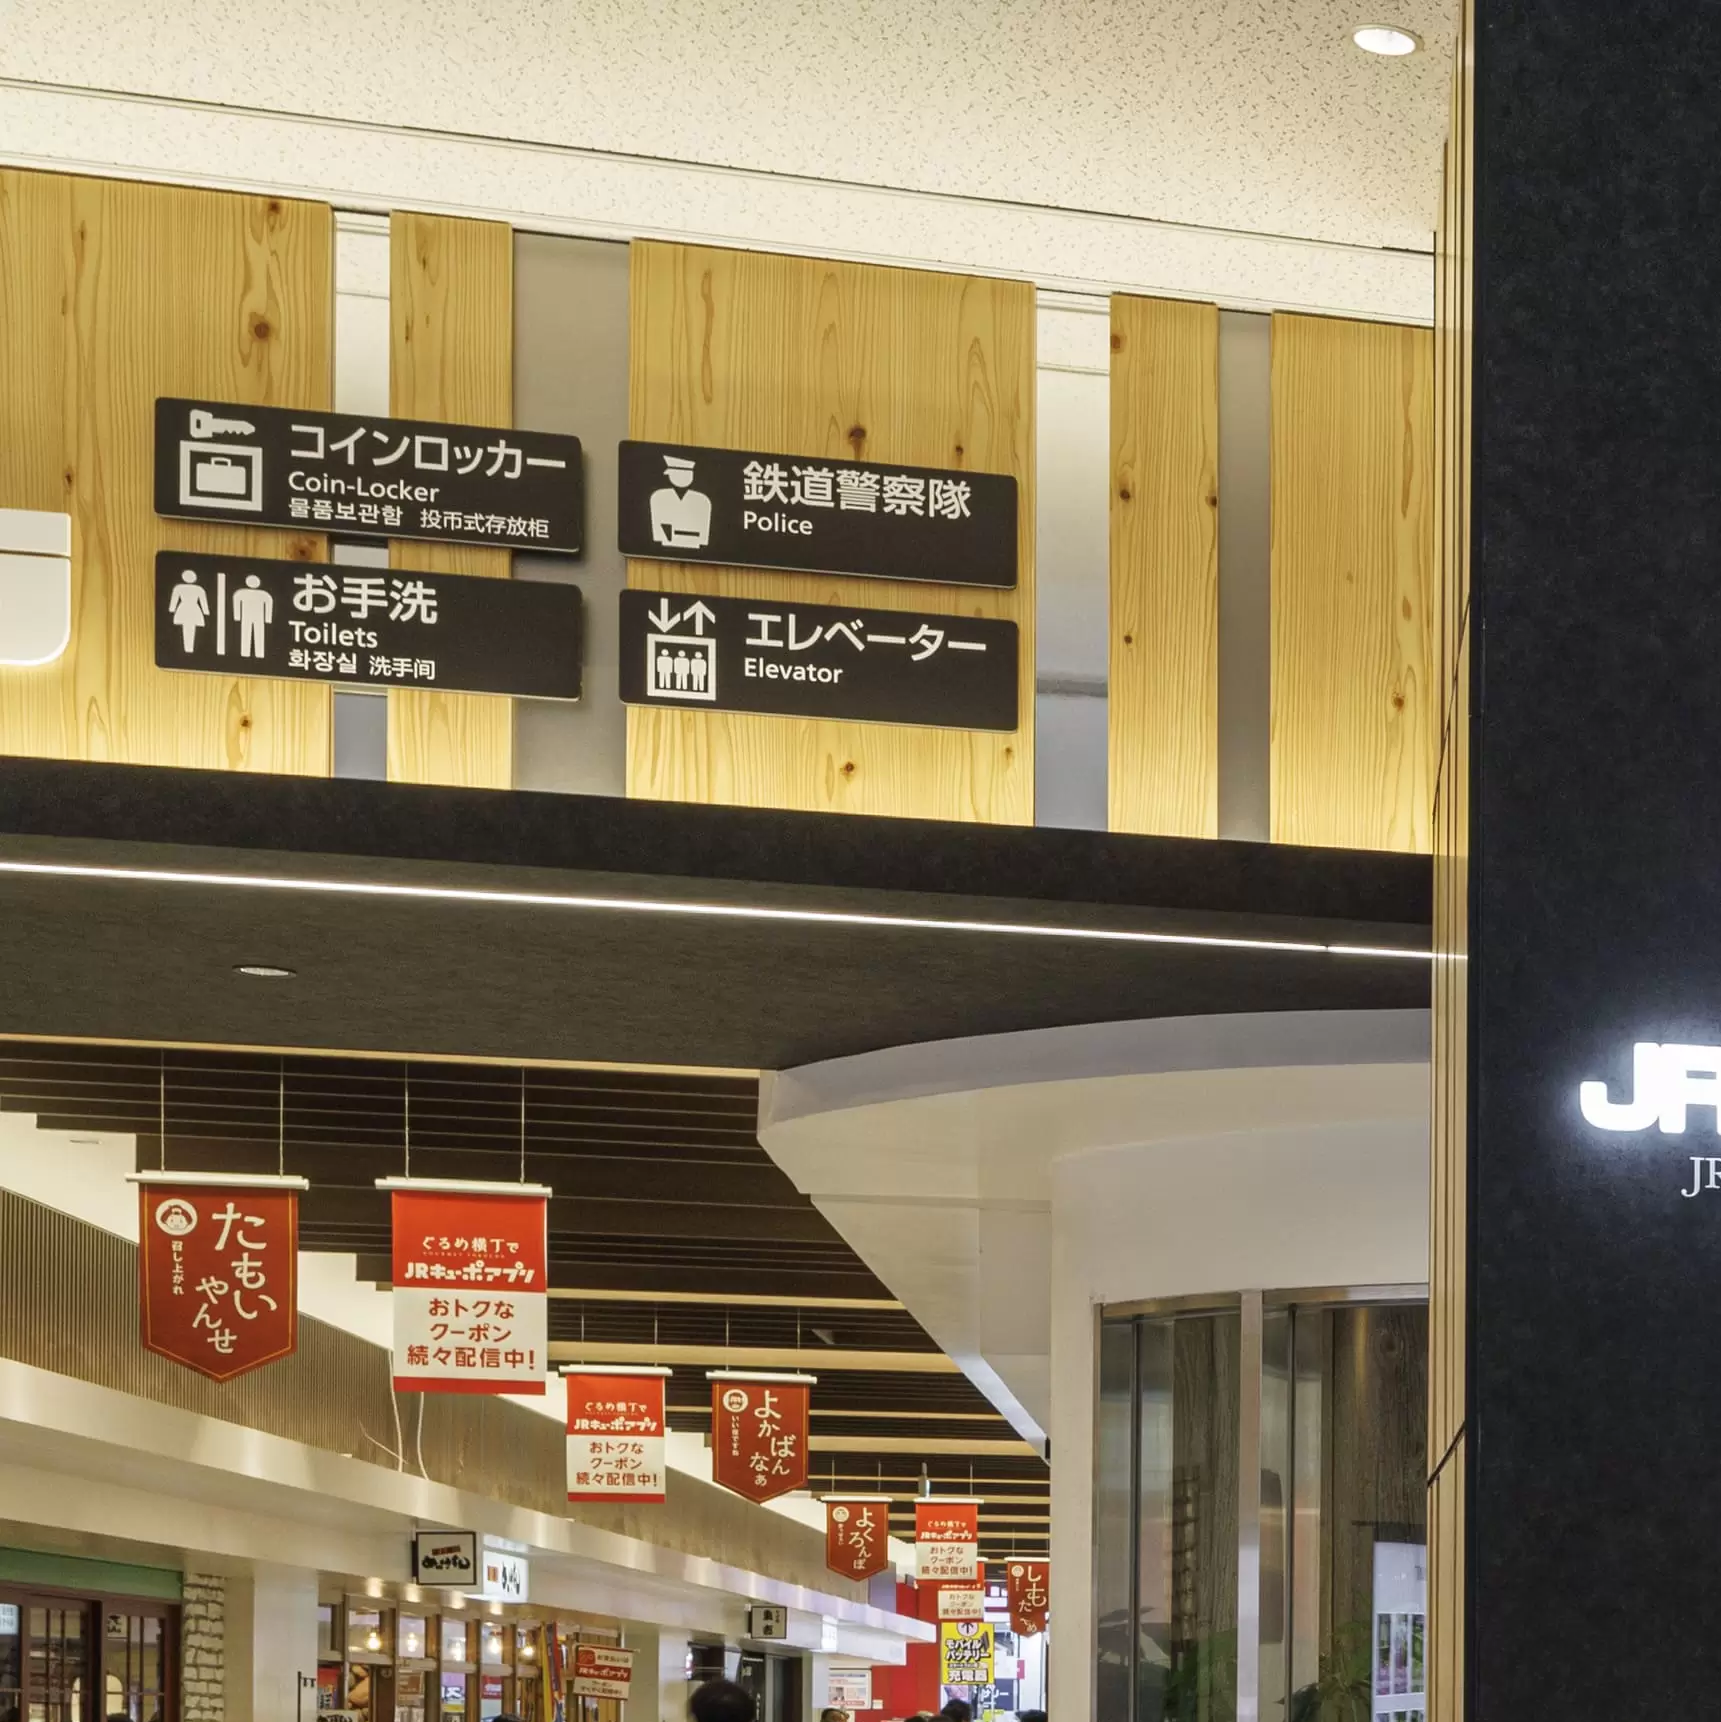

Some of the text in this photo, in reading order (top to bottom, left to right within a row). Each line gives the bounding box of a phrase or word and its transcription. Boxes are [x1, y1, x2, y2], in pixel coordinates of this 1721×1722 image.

[290, 423, 566, 479] コインロッカー
[288, 471, 440, 503] Coin-Locker
[743, 460, 972, 520] 鉄道警察隊
[288, 497, 404, 527] 물품보관함
[420, 508, 550, 539] 投币式存放柜
[743, 511, 813, 535] Police
[292, 572, 438, 625] お手洗
[288, 620, 378, 649] Toilets
[746, 612, 987, 662] エレベーター
[288, 649, 358, 675] 화장실
[369, 656, 436, 680] 洗手间
[744, 657, 843, 685] Elevator
[428, 1298, 514, 1320] おトクな
[430, 1323, 512, 1343] クーポン
[590, 1442, 644, 1455] おトクな
[590, 1457, 642, 1470] クーポン
